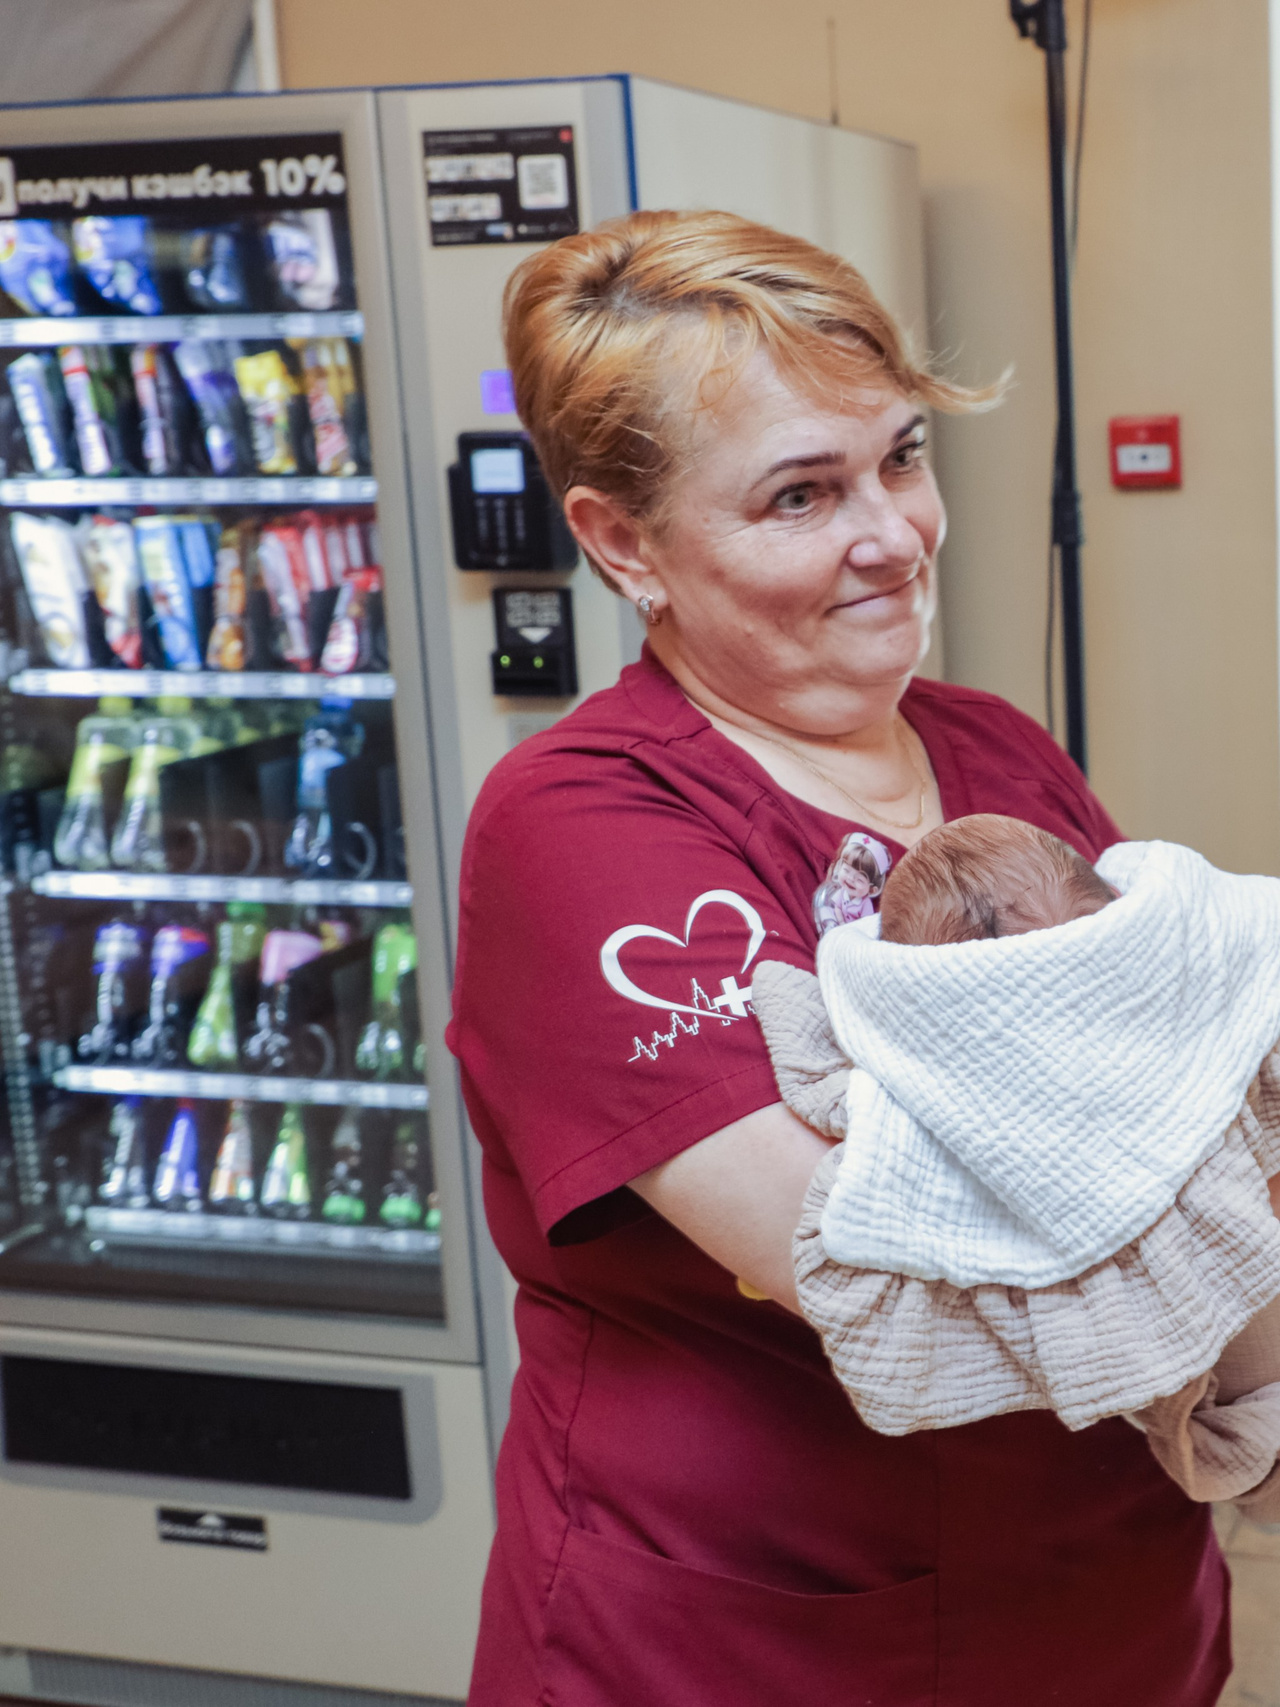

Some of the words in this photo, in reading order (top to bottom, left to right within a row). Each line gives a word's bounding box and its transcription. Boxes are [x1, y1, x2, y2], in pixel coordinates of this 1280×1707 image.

[16, 175, 129, 209] получи
[131, 164, 252, 200] кэшбэк
[260, 154, 346, 197] 10%
